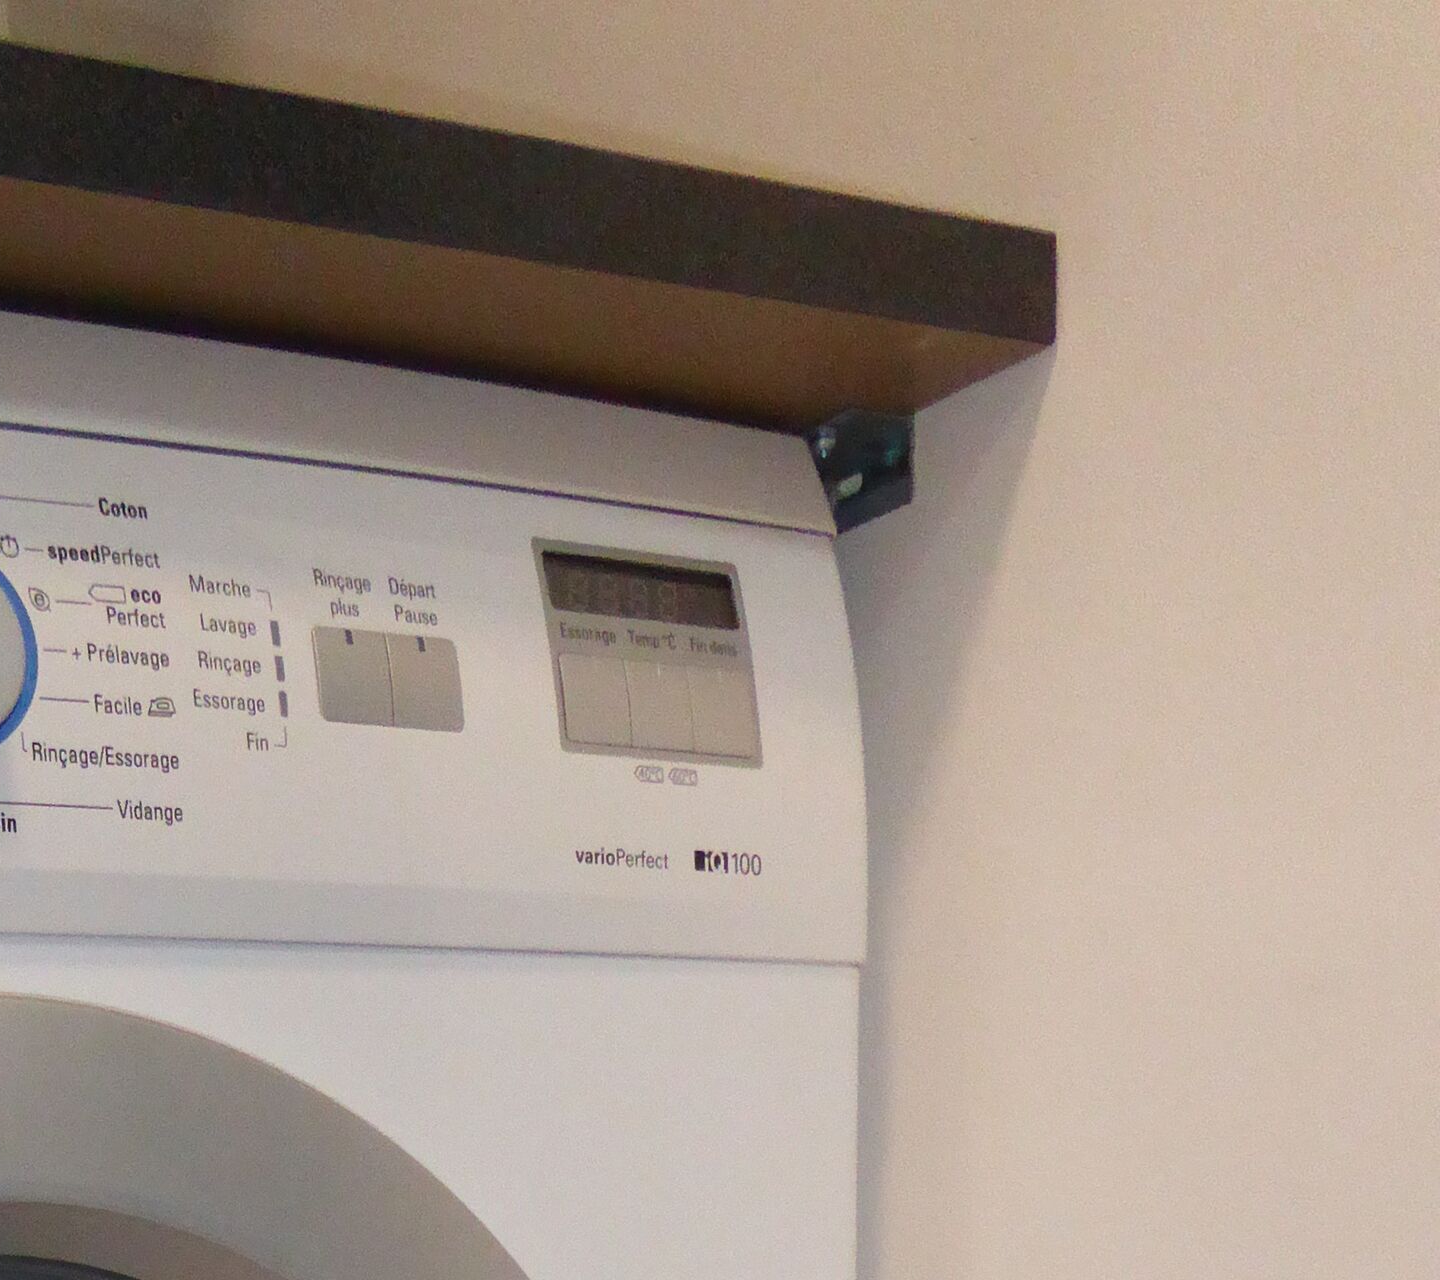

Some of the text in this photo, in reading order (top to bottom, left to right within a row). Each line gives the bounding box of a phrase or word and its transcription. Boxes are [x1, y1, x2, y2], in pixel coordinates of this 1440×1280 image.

[98, 498, 148, 520] Coton
[47, 543, 160, 569] speedPerfect
[188, 575, 252, 599] Marche
[312, 567, 372, 593] Rinçage
[388, 577, 437, 600] Départ
[130, 588, 162, 605] eco
[106, 605, 166, 630] Perfect
[330, 599, 360, 619] plus
[394, 604, 439, 627] Pause
[200, 614, 257, 638] Lavage
[87, 645, 170, 669] Prélavage
[198, 650, 262, 677] Rinçage
[93, 696, 143, 717] Facile
[193, 689, 266, 714] Essorage
[246, 732, 270, 752] Fin
[32, 742, 180, 773] Rinçage/Essorage
[116, 800, 184, 826] Vidange
[575, 848, 669, 870] varioPerfect
